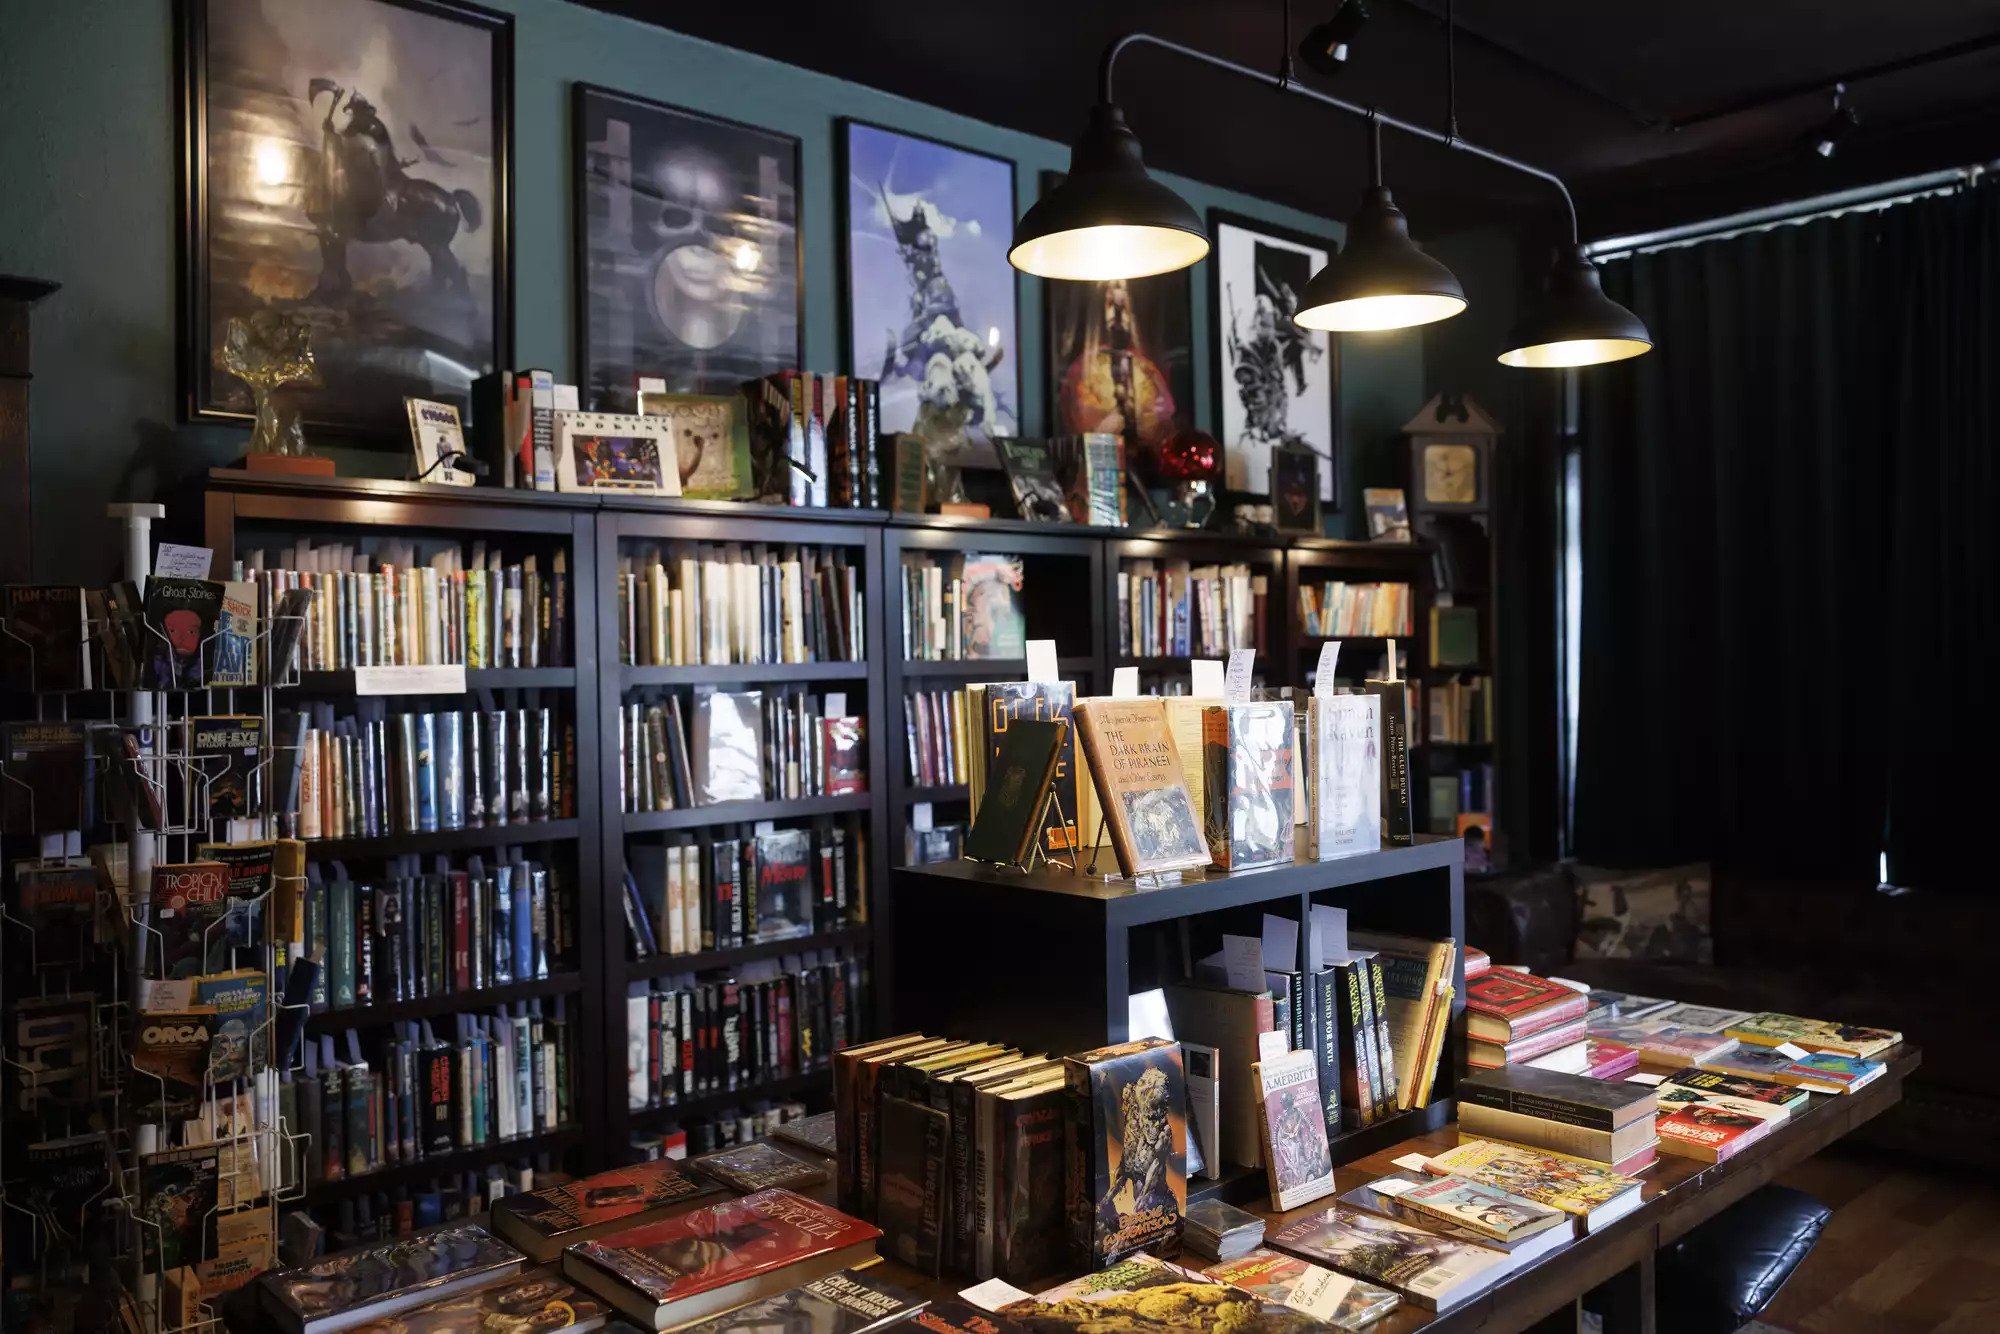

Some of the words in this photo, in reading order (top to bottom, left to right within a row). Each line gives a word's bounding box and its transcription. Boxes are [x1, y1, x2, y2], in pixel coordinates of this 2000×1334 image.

[162, 584, 187, 599] Ghost
[188, 587, 217, 601] Stories
[226, 601, 252, 617] SHOCK
[1104, 730, 1124, 742] THE
[1109, 744, 1137, 756] DARK
[1138, 741, 1170, 754] BRAIN
[1113, 758, 1127, 770] OF
[1127, 755, 1171, 770] PIRANESI
[1399, 776, 1407, 804] DUMAS
[164, 872, 224, 891] TROPICAL
[186, 885, 225, 902] CHILLS
[1323, 983, 1333, 1018] BOUND
[142, 1025, 210, 1045] ORCA
[1324, 1020, 1333, 1042] FOR
[1325, 1042, 1334, 1065] EVIL
[1265, 1066, 1317, 1091] A.MERRITT
[756, 1200, 842, 1241] DRACULA
[976, 1197, 985, 1233] ANGELS
[806, 1280, 839, 1299] TALES
[837, 1293, 889, 1318] HORROR
[823, 1275, 870, 1296] GREAT
[860, 1290, 904, 1310] IRISH
